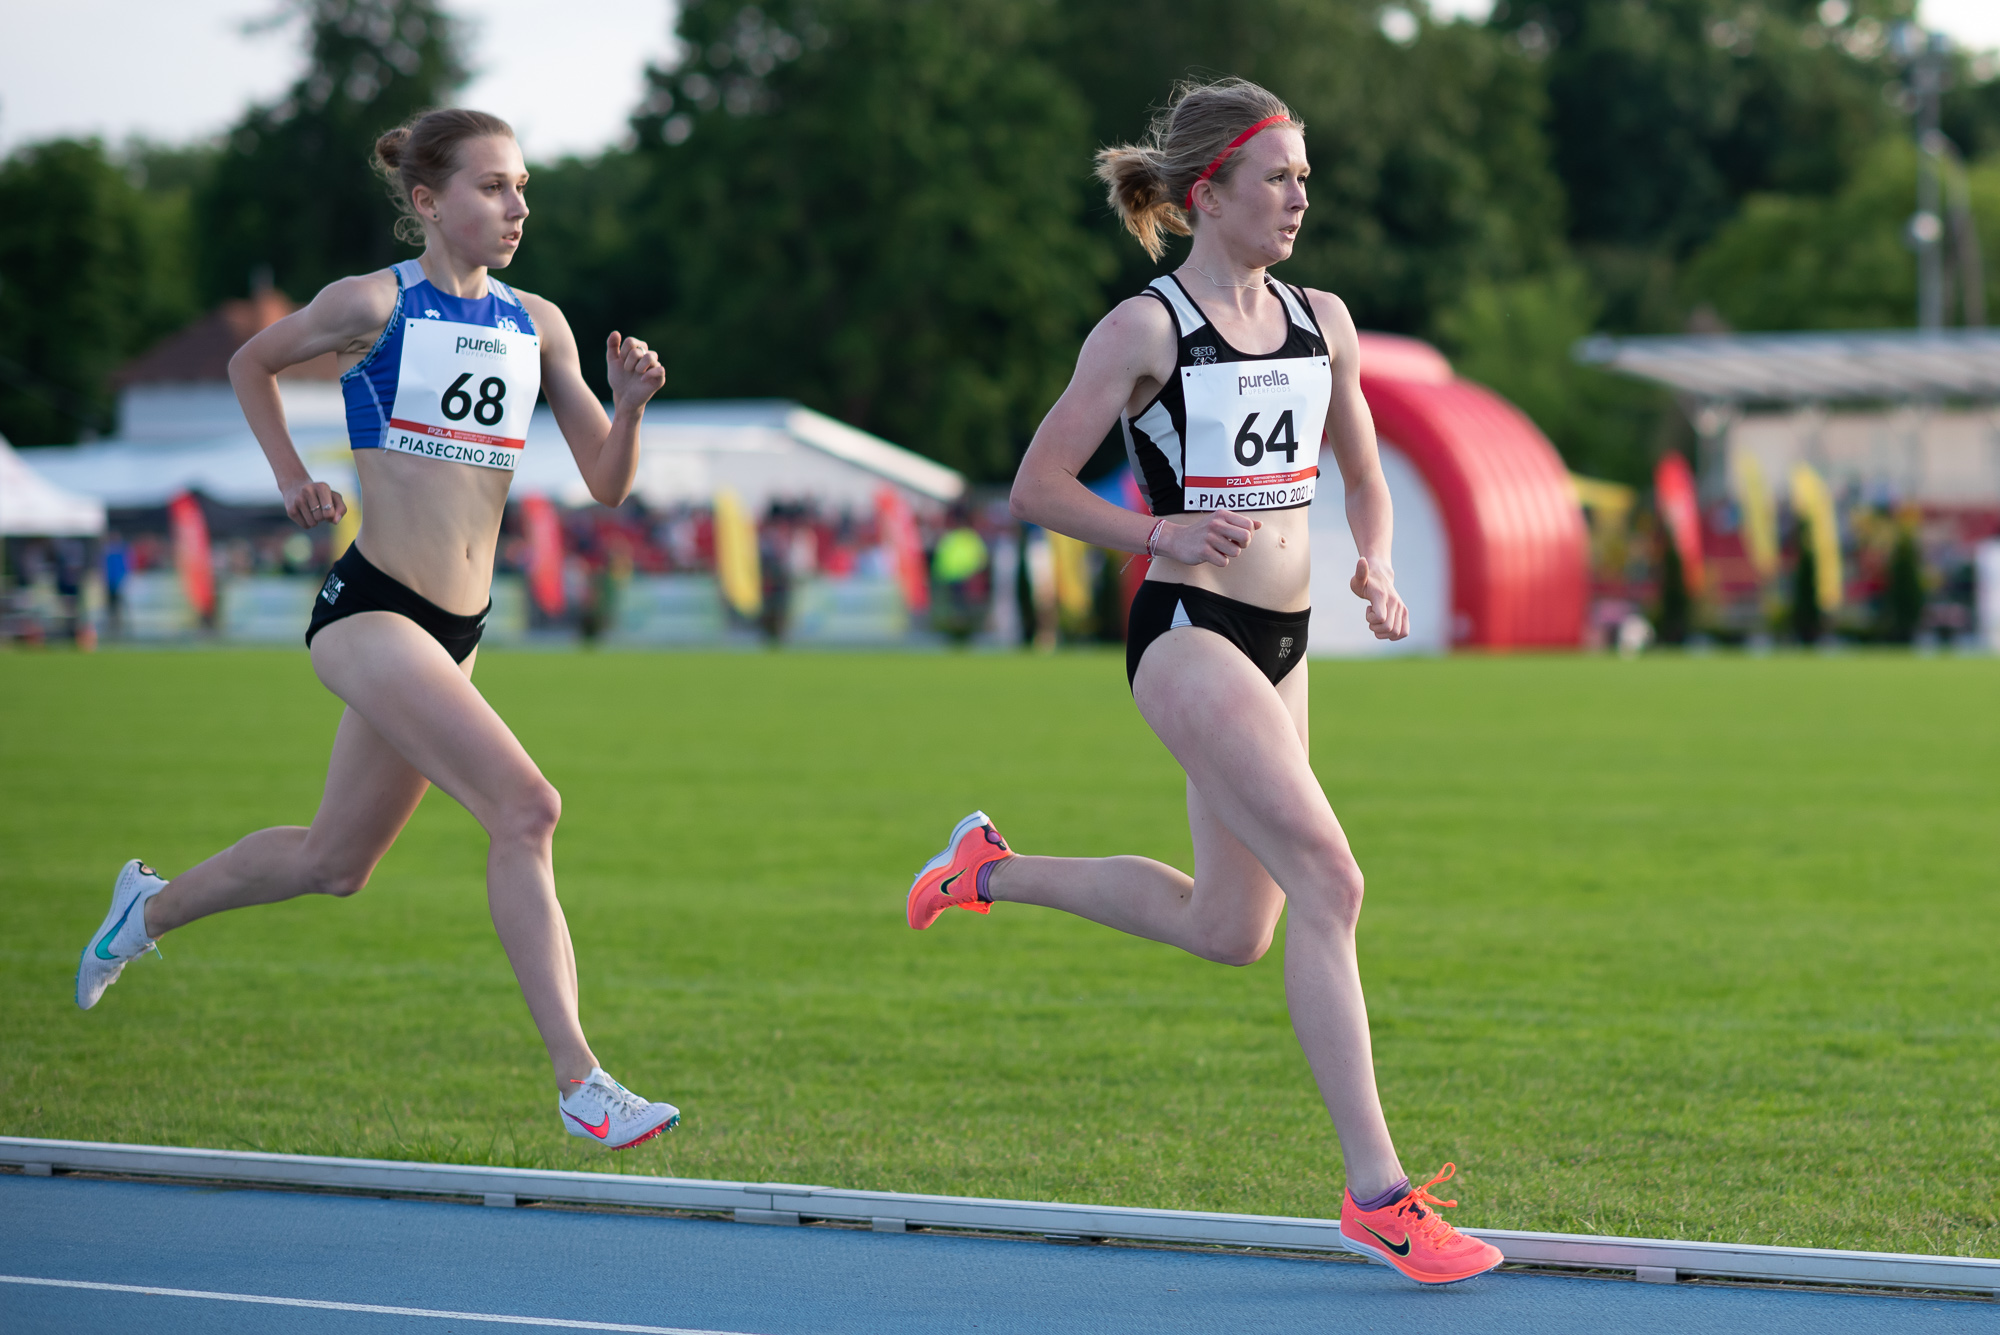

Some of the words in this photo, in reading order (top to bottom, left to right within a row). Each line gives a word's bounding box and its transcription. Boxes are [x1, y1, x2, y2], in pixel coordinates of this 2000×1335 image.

[455, 336, 507, 355] purella
[1238, 370, 1290, 395] purella
[1243, 386, 1292, 396] SUPERFOODS
[440, 372, 507, 426] 68
[427, 426, 453, 438] PZLA
[1234, 409, 1299, 467] 64
[399, 435, 485, 463] PIASECZNO
[488, 451, 515, 468] 2021
[1226, 477, 1252, 486] PZLA
[1199, 489, 1287, 508] PIASECZNO
[1290, 484, 1309, 503] 2021
